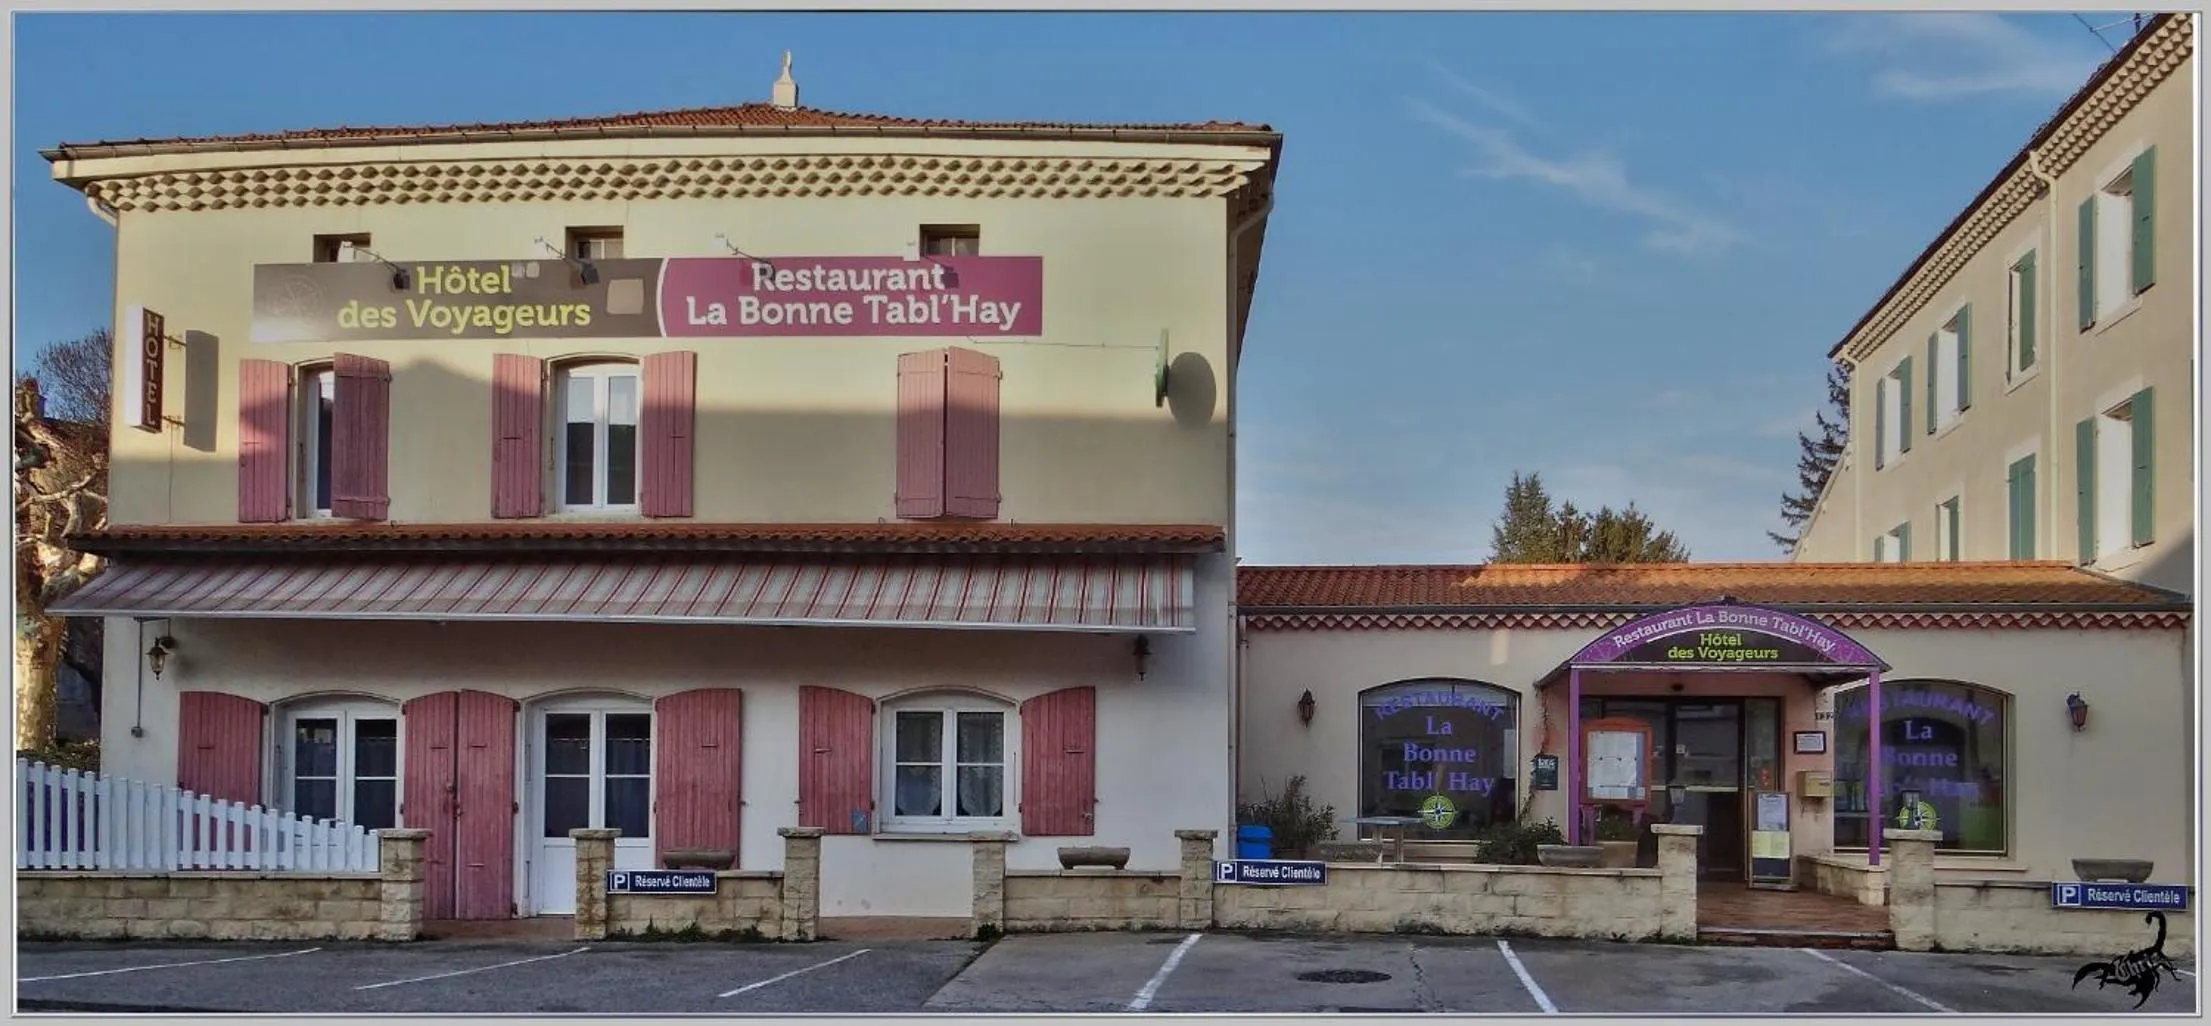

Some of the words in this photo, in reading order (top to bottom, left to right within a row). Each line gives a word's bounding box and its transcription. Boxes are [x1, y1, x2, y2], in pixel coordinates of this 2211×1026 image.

[416, 264, 513, 295] Hôtel
[751, 263, 945, 291] Restaurant
[337, 300, 397, 328] des
[406, 299, 592, 335] Voyageurs
[687, 296, 728, 325] La
[738, 296, 853, 325] Bonne
[863, 294, 1022, 331] Tabl'Hay
[146, 313, 160, 426] HOTEL
[1613, 615, 1693, 648] Restaurant
[1696, 613, 1715, 625] La
[1718, 611, 1769, 626] Bonne
[1771, 616, 1837, 654] Tabl'Hay
[1700, 633, 1742, 646] Hôtel
[1668, 646, 1695, 659] des
[1697, 647, 1779, 662] Voyageurs
[1426, 716, 1453, 735] La
[1904, 720, 1933, 740] La
[1403, 741, 1477, 763] Bonne
[1447, 772, 1496, 797] Hay
[634, 874, 671, 888] Réservé
[672, 874, 711, 888] Clientèle
[1243, 865, 1279, 878] Réservé
[1281, 865, 1321, 880] Clientèle
[2087, 887, 2131, 902] Réservé
[2133, 888, 2180, 904] Clientèle
